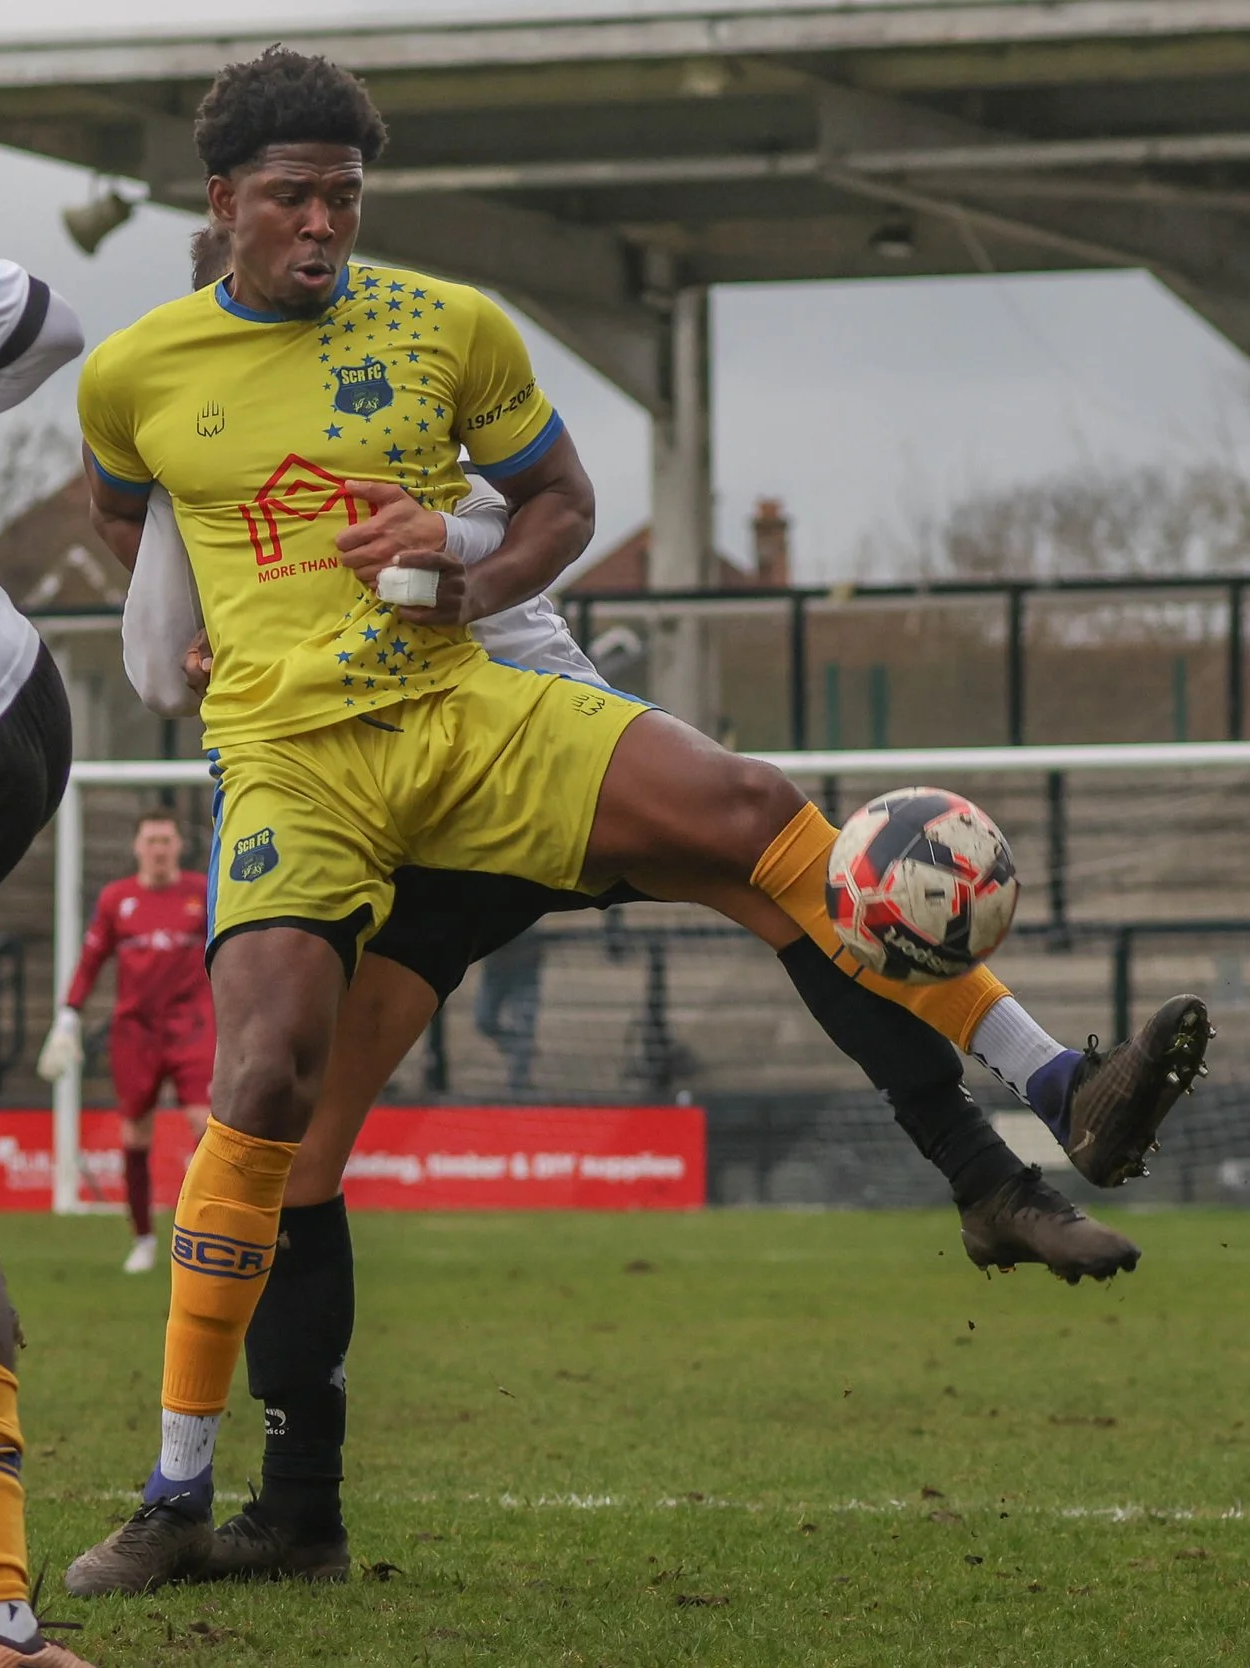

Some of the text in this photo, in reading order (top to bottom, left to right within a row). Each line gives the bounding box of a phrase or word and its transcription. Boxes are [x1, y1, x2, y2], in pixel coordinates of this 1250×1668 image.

[341, 363, 382, 385] SCR FC
[258, 556, 339, 584] MORE THAN
[237, 830, 269, 854] SCR FC
[174, 1234, 264, 1270] SCR
